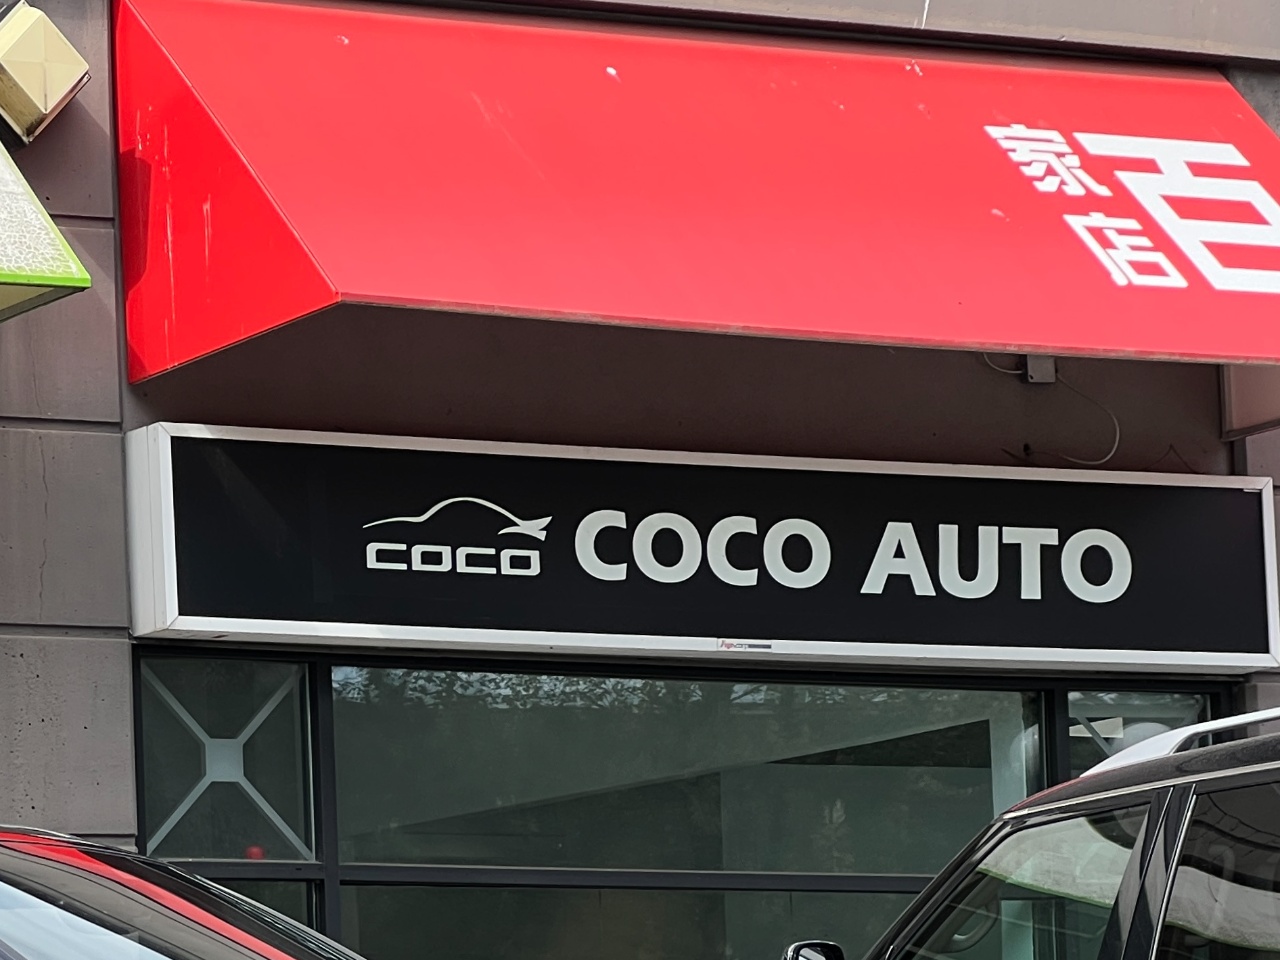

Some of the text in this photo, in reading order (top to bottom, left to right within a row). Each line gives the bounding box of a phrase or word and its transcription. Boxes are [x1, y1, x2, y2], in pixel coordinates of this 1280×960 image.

[366, 542, 541, 576] COCO
[574, 509, 1133, 604] COCO AUTO
